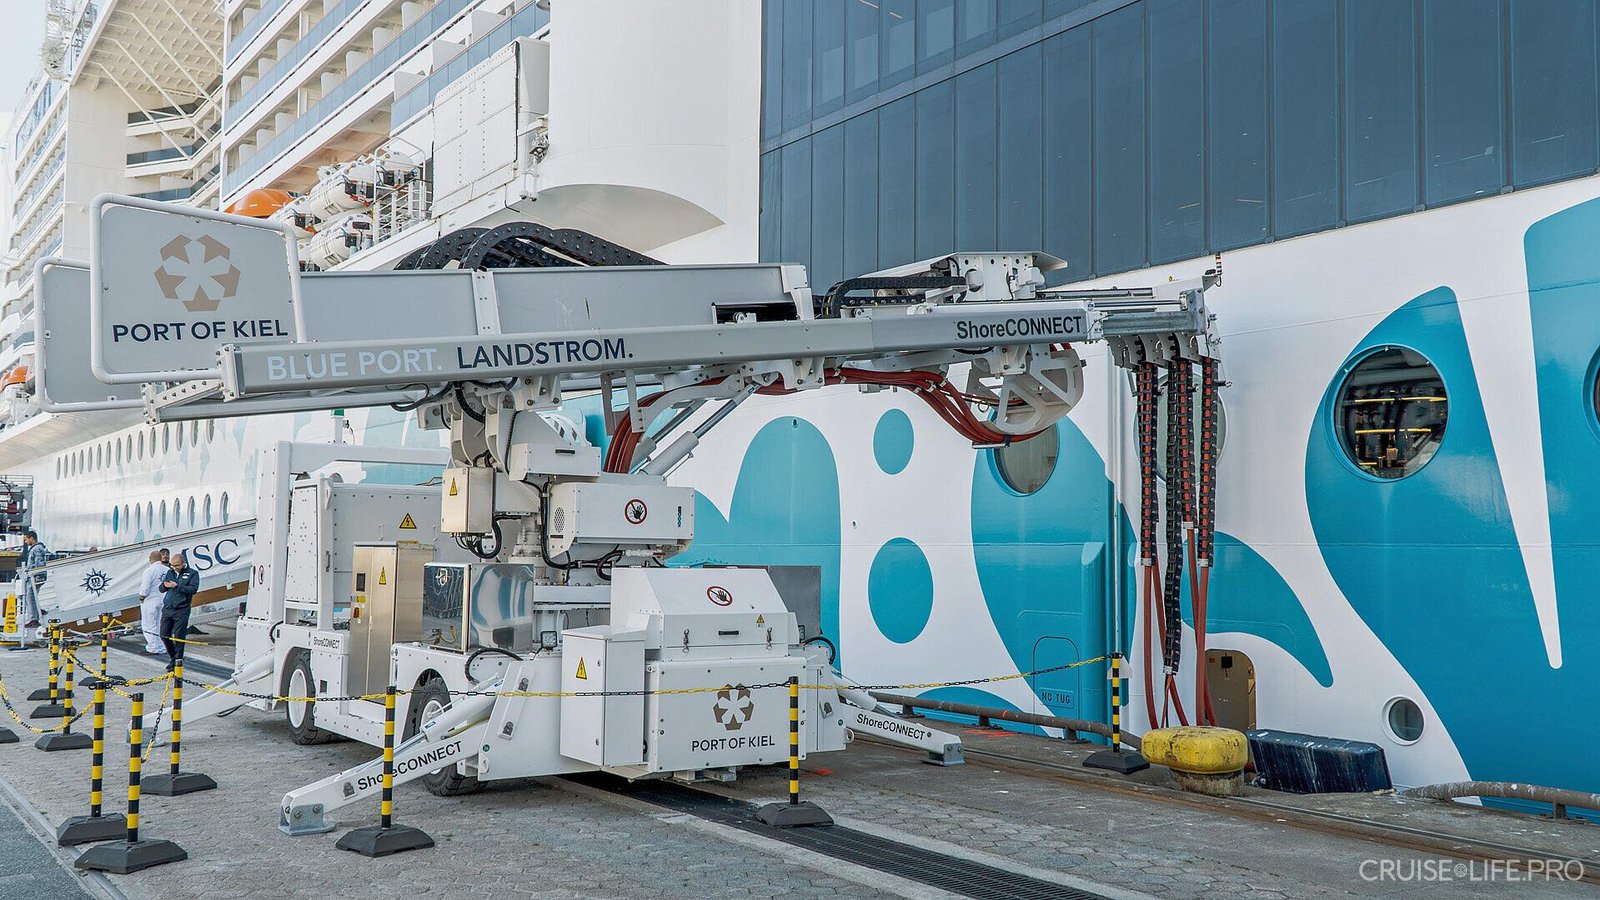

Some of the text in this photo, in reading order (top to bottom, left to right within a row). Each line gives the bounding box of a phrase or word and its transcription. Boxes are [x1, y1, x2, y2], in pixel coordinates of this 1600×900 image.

[112, 319, 288, 343] PORT OF KIEL
[956, 316, 1082, 340] ShoreCONNECT
[267, 337, 634, 381] BLUE PORT. LANDSTROM.
[1041, 691, 1071, 704] NO TUG
[856, 713, 926, 741] ShoreCONNECT
[692, 735, 776, 752] PORT OF KIEL
[357, 740, 462, 791] ShoeCONNECT
